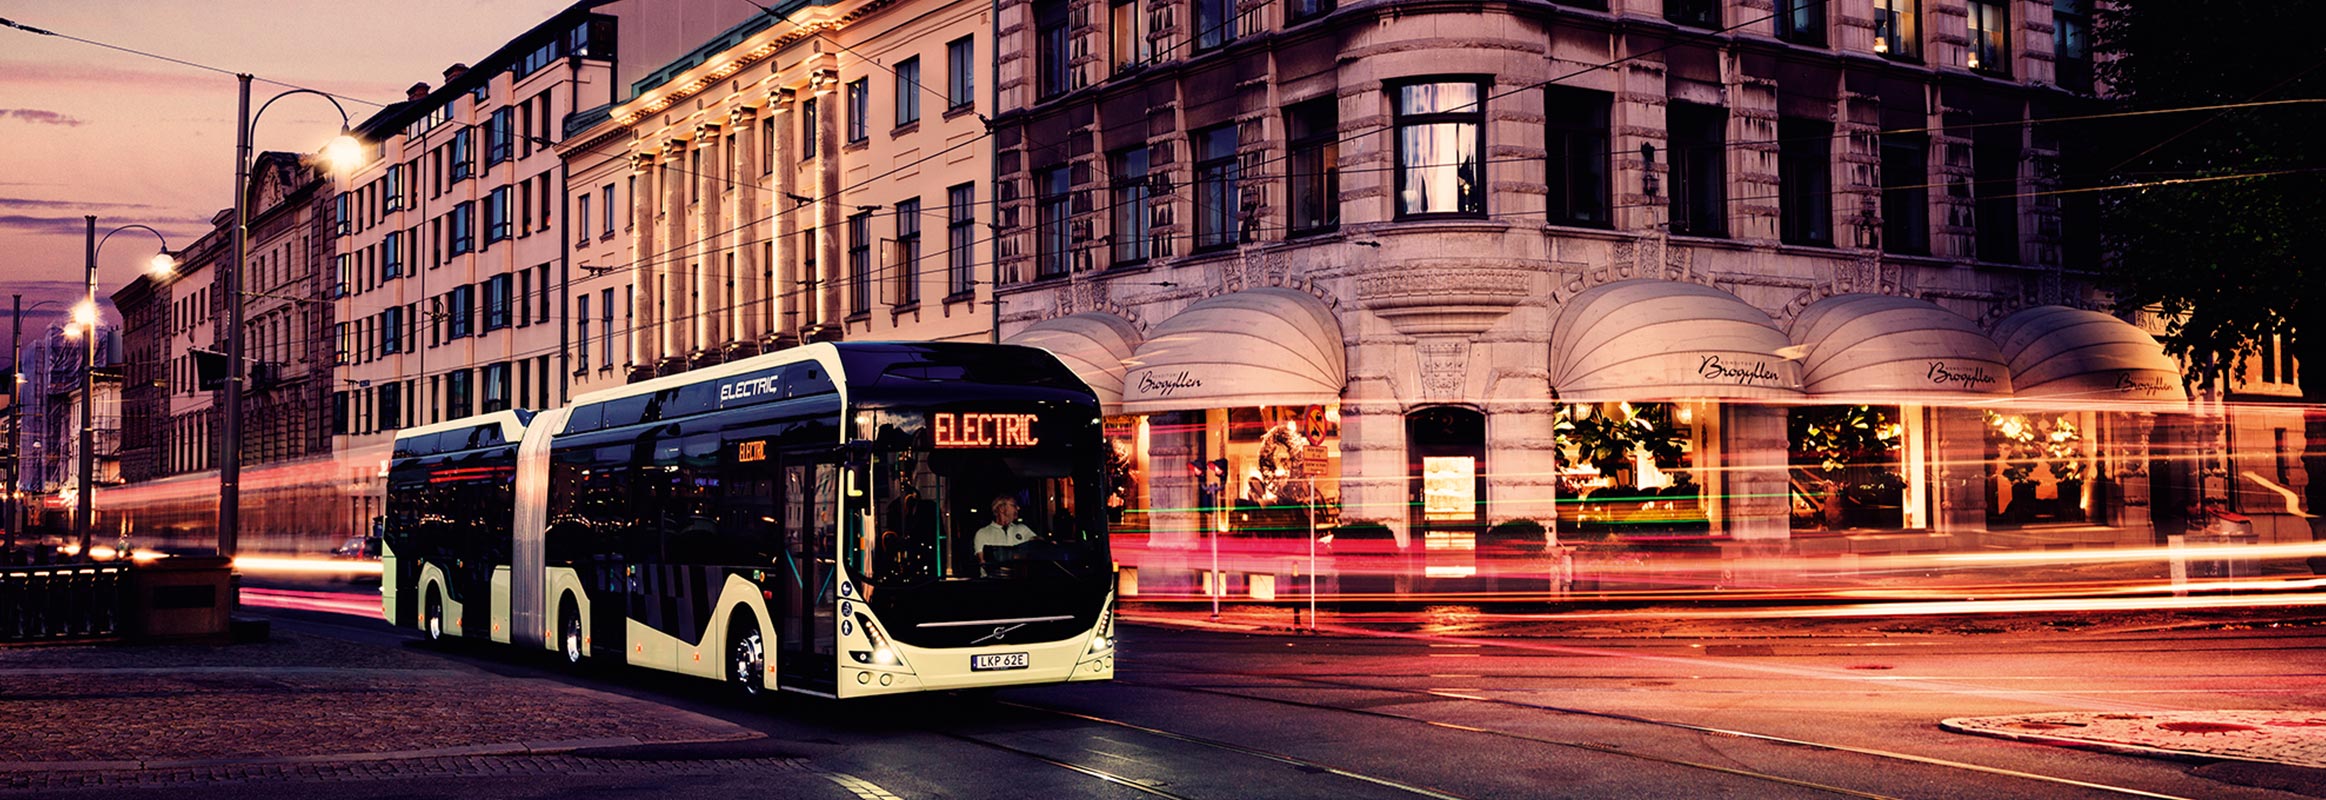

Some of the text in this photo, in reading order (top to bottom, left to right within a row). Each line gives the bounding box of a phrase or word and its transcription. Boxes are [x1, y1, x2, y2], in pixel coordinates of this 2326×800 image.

[1698, 355, 1779, 384] Brogyllen
[1927, 361, 1996, 388] Brogyllen
[720, 375, 778, 400] ELECTRIC
[1138, 370, 1203, 396] Brogyllen
[935, 413, 1039, 446] ELECTRIC
[739, 440, 767, 462] ELECTRIC
[981, 654, 1024, 667] LKP 62E
